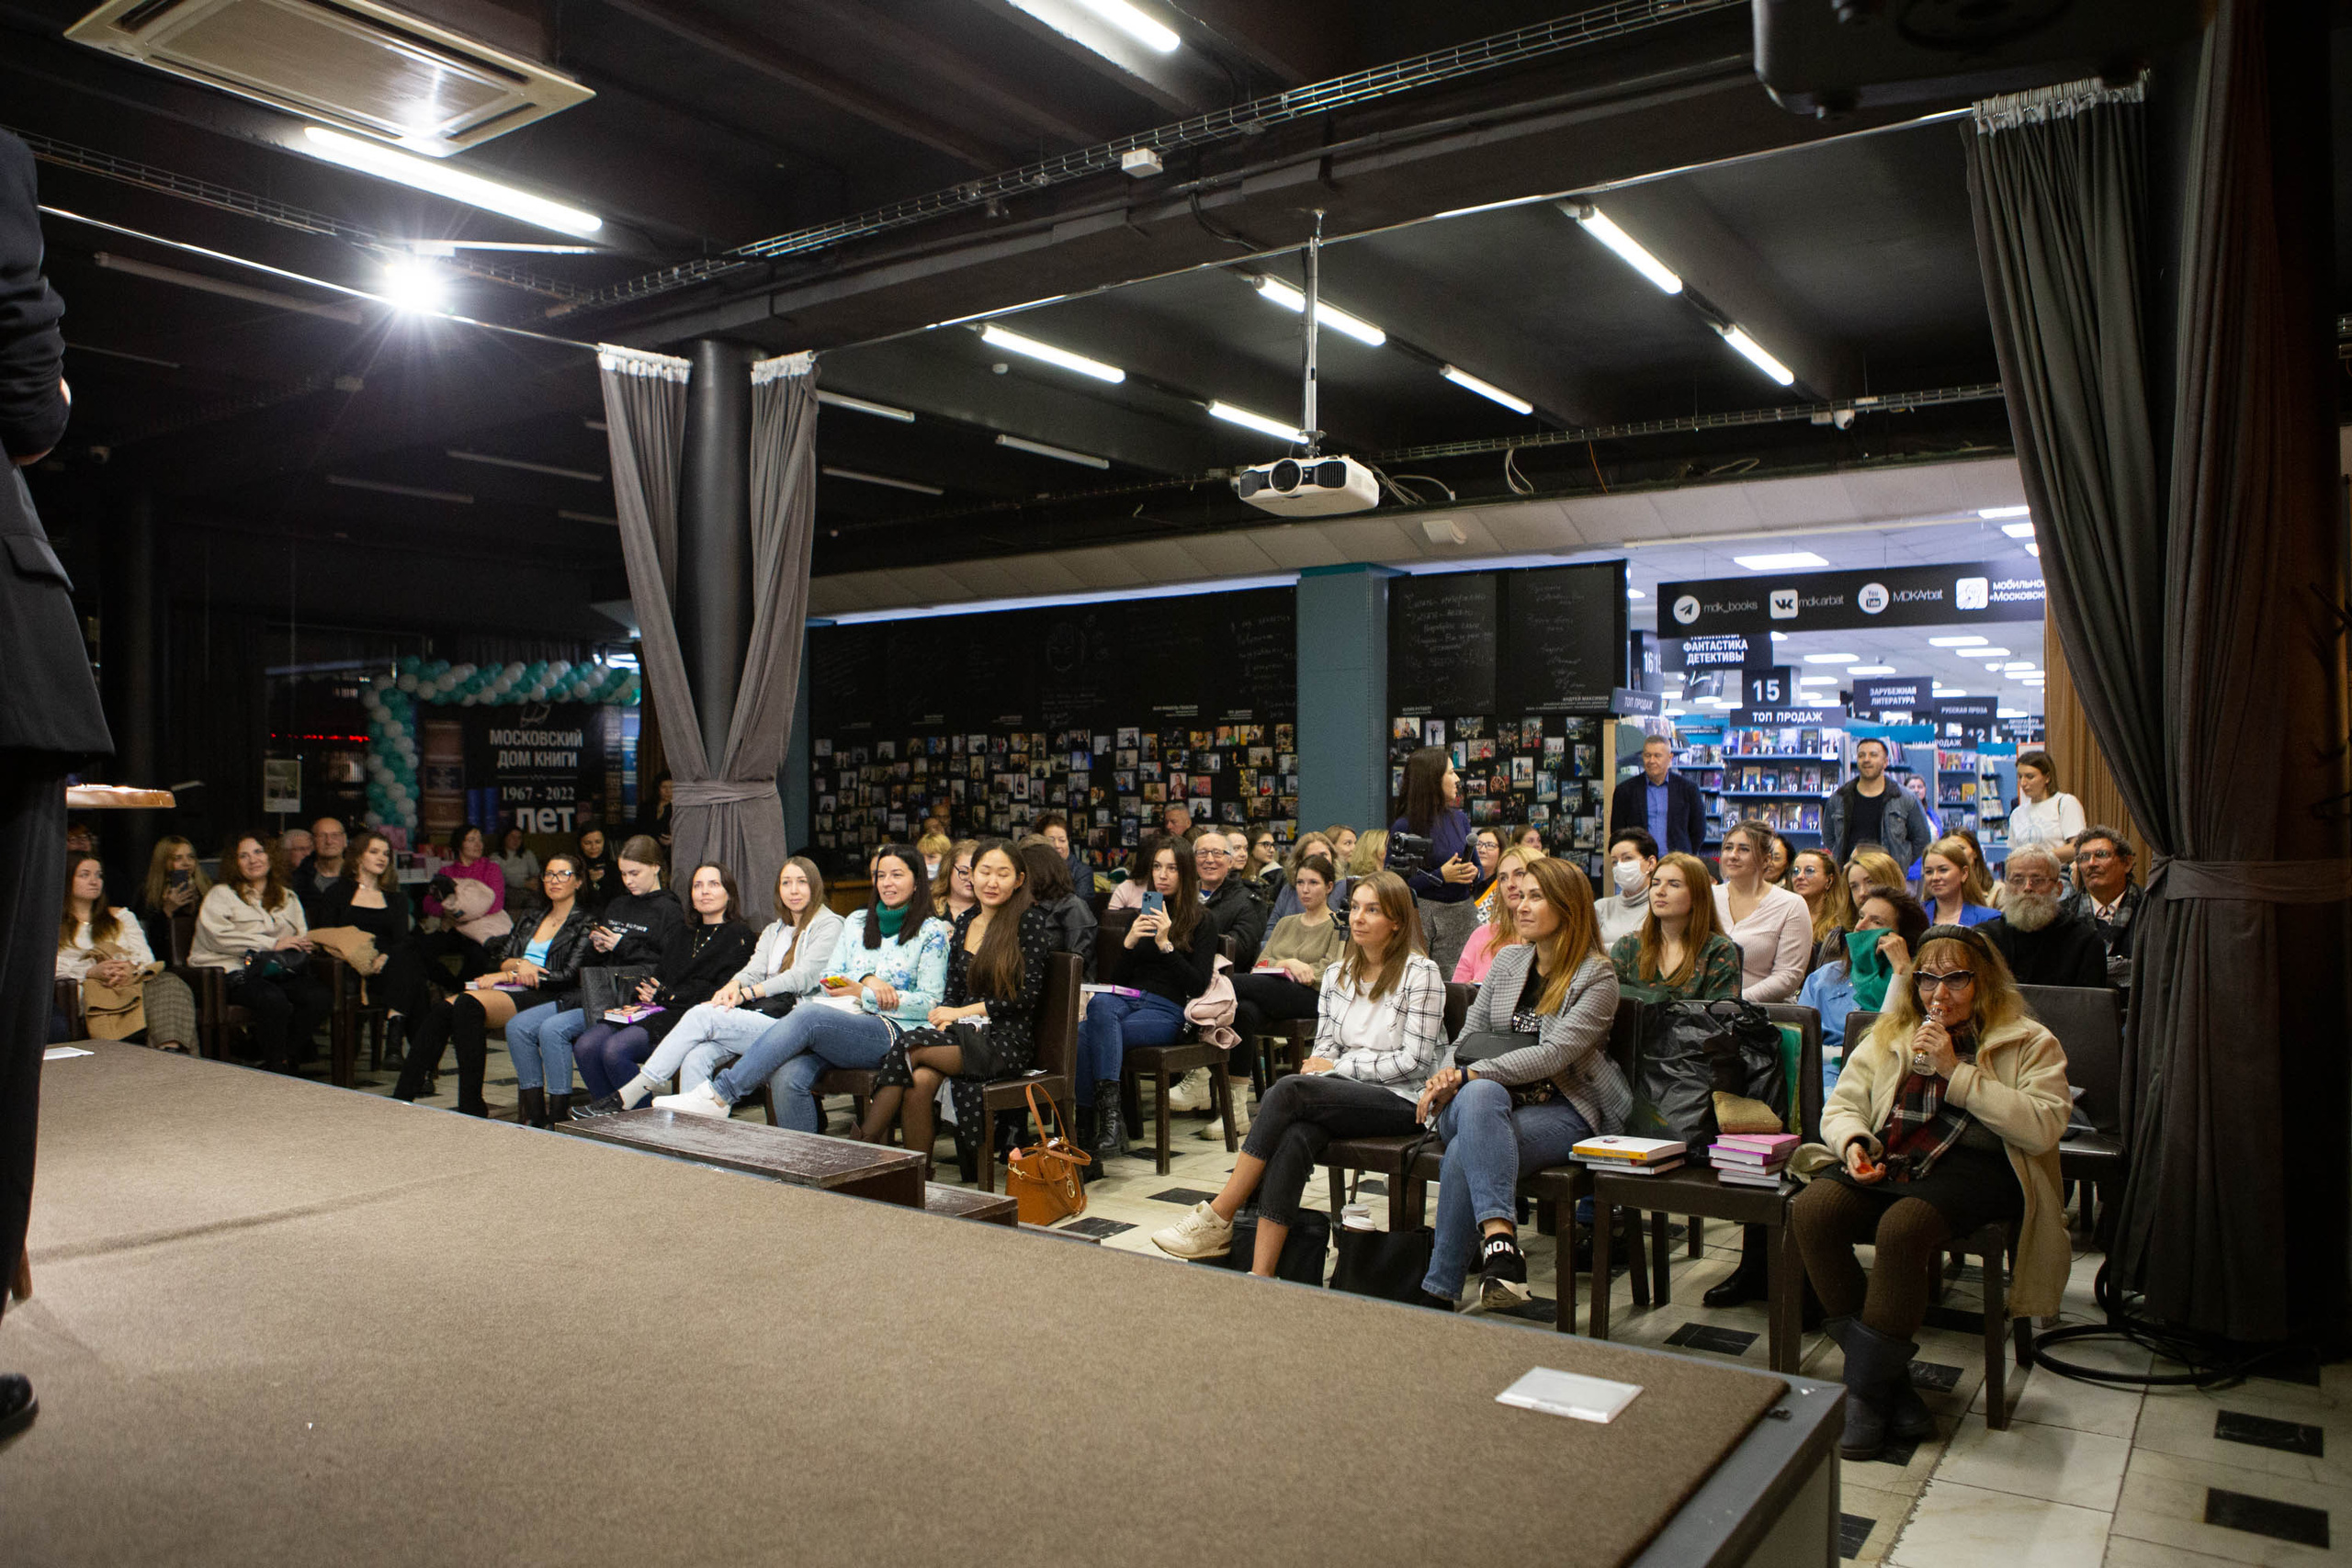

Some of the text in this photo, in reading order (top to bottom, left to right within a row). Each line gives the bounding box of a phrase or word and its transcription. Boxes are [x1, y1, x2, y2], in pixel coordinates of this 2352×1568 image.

[1993, 579, 2045, 591] мобильно
[1893, 589, 1943, 603] MDKArbat
[1703, 600, 1758, 614] mdk_books
[1683, 639, 1749, 653] ФАНТАСТИКА
[1687, 651, 1745, 666] ДЕТЕКТИВЫ
[1752, 679, 1781, 702] 15
[1870, 686, 1917, 697] ЗАРУБЕЖНАЯ
[1624, 696, 1654, 711] ТОП ПРОДАЖ
[1871, 695, 1916, 706] ЛИТЕРАТУРА
[1752, 711, 1823, 724] ТОП ПРОДАЖ
[490, 728, 583, 747] МОСКОВСКИЙ
[497, 750, 578, 769] ДОМ КНИГИ
[503, 786, 533, 801] 1967
[546, 786, 575, 800] 2022
